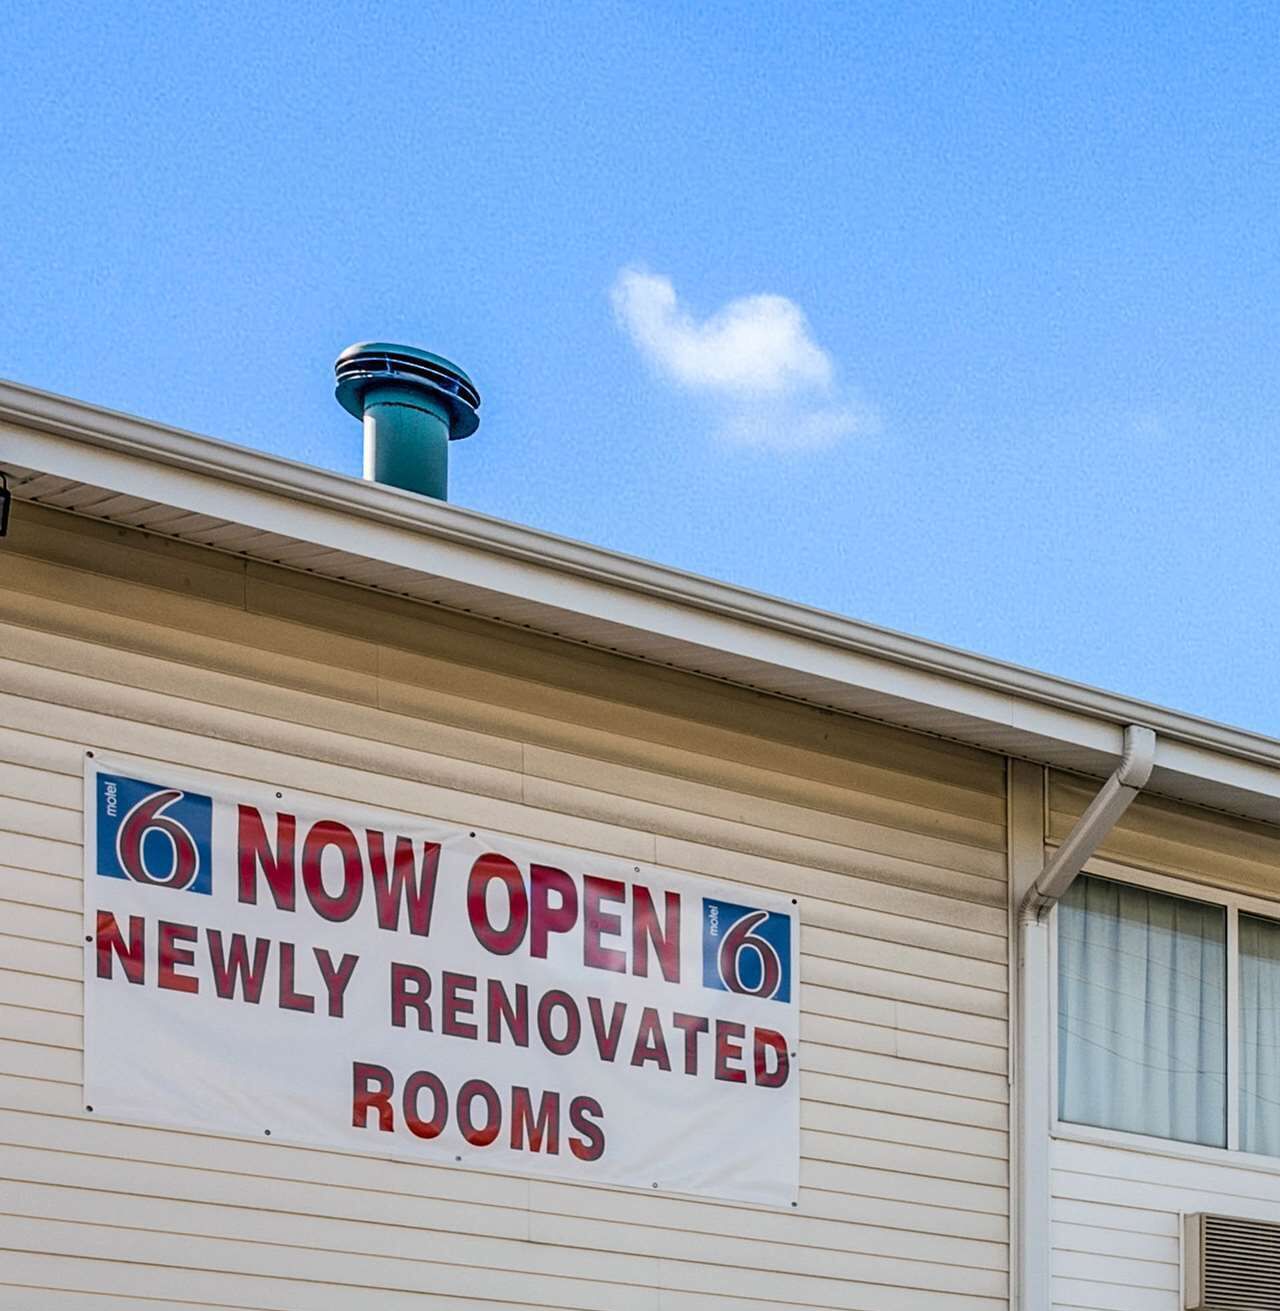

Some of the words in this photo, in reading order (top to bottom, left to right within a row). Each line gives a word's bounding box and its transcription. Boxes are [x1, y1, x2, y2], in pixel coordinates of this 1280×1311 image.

[104, 781, 117, 817] motel
[116, 788, 200, 891] 6
[237, 804, 442, 937] NOW
[467, 852, 681, 984] OPEN
[708, 905, 719, 936] motel
[96, 909, 360, 1018] NEWLY
[391, 962, 789, 1088] RENOVATED
[717, 910, 782, 999] 6
[352, 1061, 605, 1161] ROOMS
